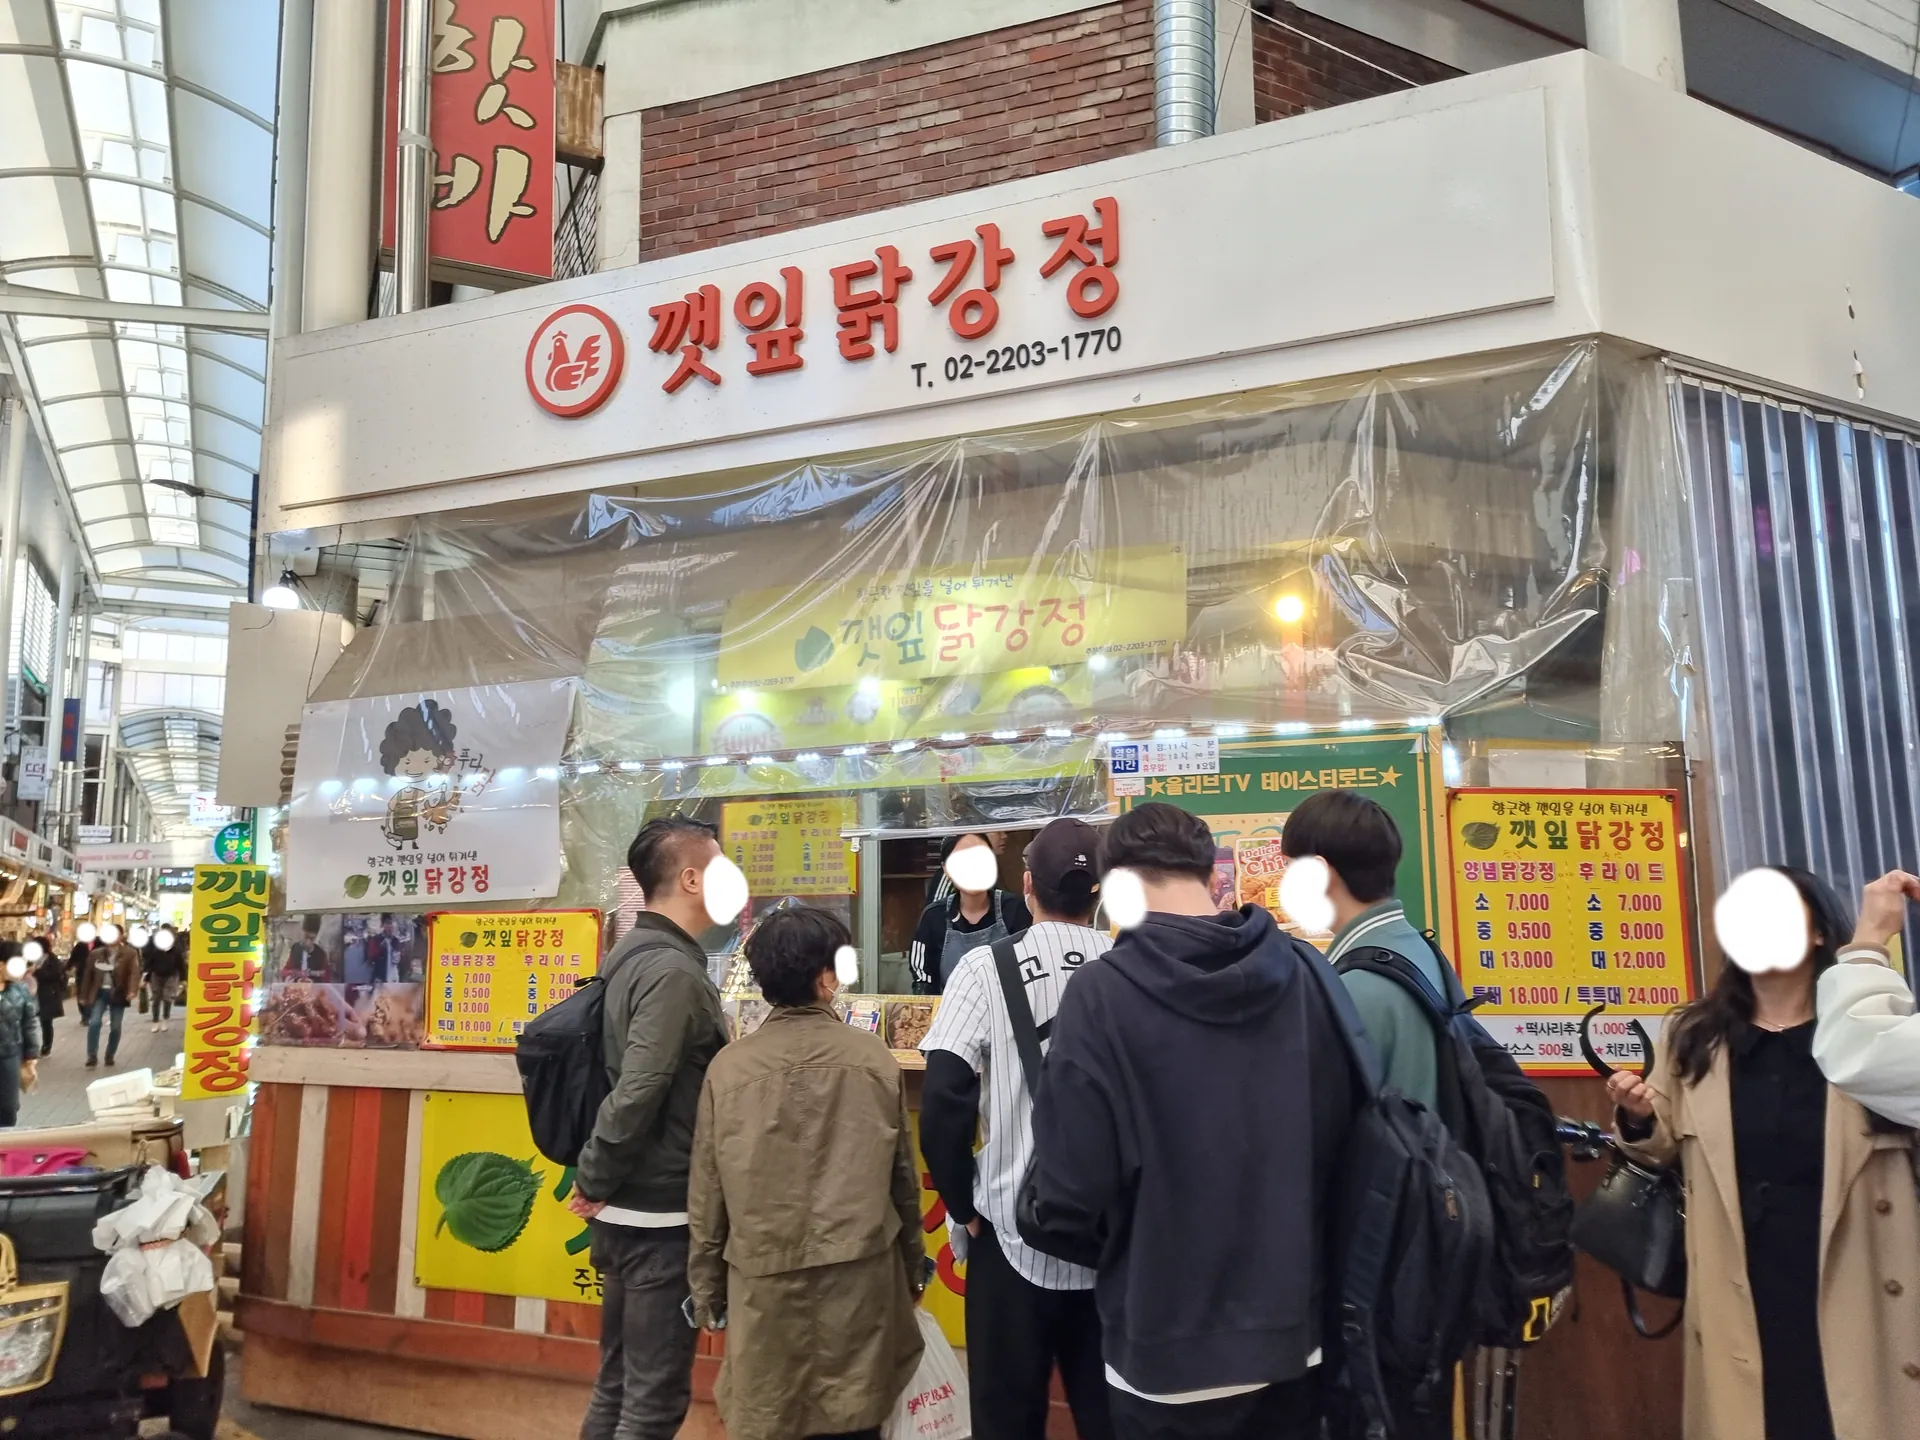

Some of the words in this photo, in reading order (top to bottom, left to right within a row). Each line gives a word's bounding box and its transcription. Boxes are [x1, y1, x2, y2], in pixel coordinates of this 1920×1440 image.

[648, 196, 1120, 394] 깻잎닭강정
[911, 362, 934, 388] T.
[944, 325, 1122, 382] 02-2203-1770
[839, 596, 1086, 668] 깻잎닭강정
[1114, 747, 1136, 759] 영업
[25, 762, 46, 782] 떡
[1114, 760, 1137, 772] 시간
[1165, 774, 1252, 796] 올리브TV
[1260, 767, 1380, 793] 테이스티로드
[1492, 800, 1531, 817] 향긋한
[1536, 801, 1574, 817] 깻잎을
[1610, 802, 1648, 817] 튀겨낸
[1509, 819, 1665, 852] 깻잎닭강정
[1244, 844, 1281, 858] Delicio
[1245, 856, 1288, 876] Chi
[1463, 861, 1555, 882] 양념닭강정
[1579, 862, 1664, 882] 후라이드
[377, 864, 490, 898] 깻잎닭강정
[1475, 893, 1490, 911] 소
[1505, 893, 1549, 912] 7,000
[1587, 893, 1602, 912] 소
[1618, 894, 1662, 912] 7,000
[483, 929, 564, 948] 깻잎닭강정
[1476, 921, 1492, 941] 중
[1507, 922, 1551, 940] 9,500
[1588, 922, 1604, 941] 중
[1620, 922, 1665, 941] 9,000
[524, 954, 581, 967] 후라이드
[1479, 950, 1495, 970] 대
[1501, 951, 1554, 969] 13,000
[1591, 950, 1607, 970] 대
[1613, 951, 1666, 970] 12,000
[188, 869, 268, 1093] 깻잎닭강정
[445, 972, 453, 984] 소
[528, 972, 537, 985] 소
[444, 986, 453, 999] 중
[528, 987, 537, 1000] 중
[1576, 986, 1622, 1006] 특특대
[444, 1001, 453, 1013] 대
[528, 1002, 538, 1014] 대
[1538, 1042, 1573, 1057] 500원
[1605, 1042, 1643, 1057] 치킨무
